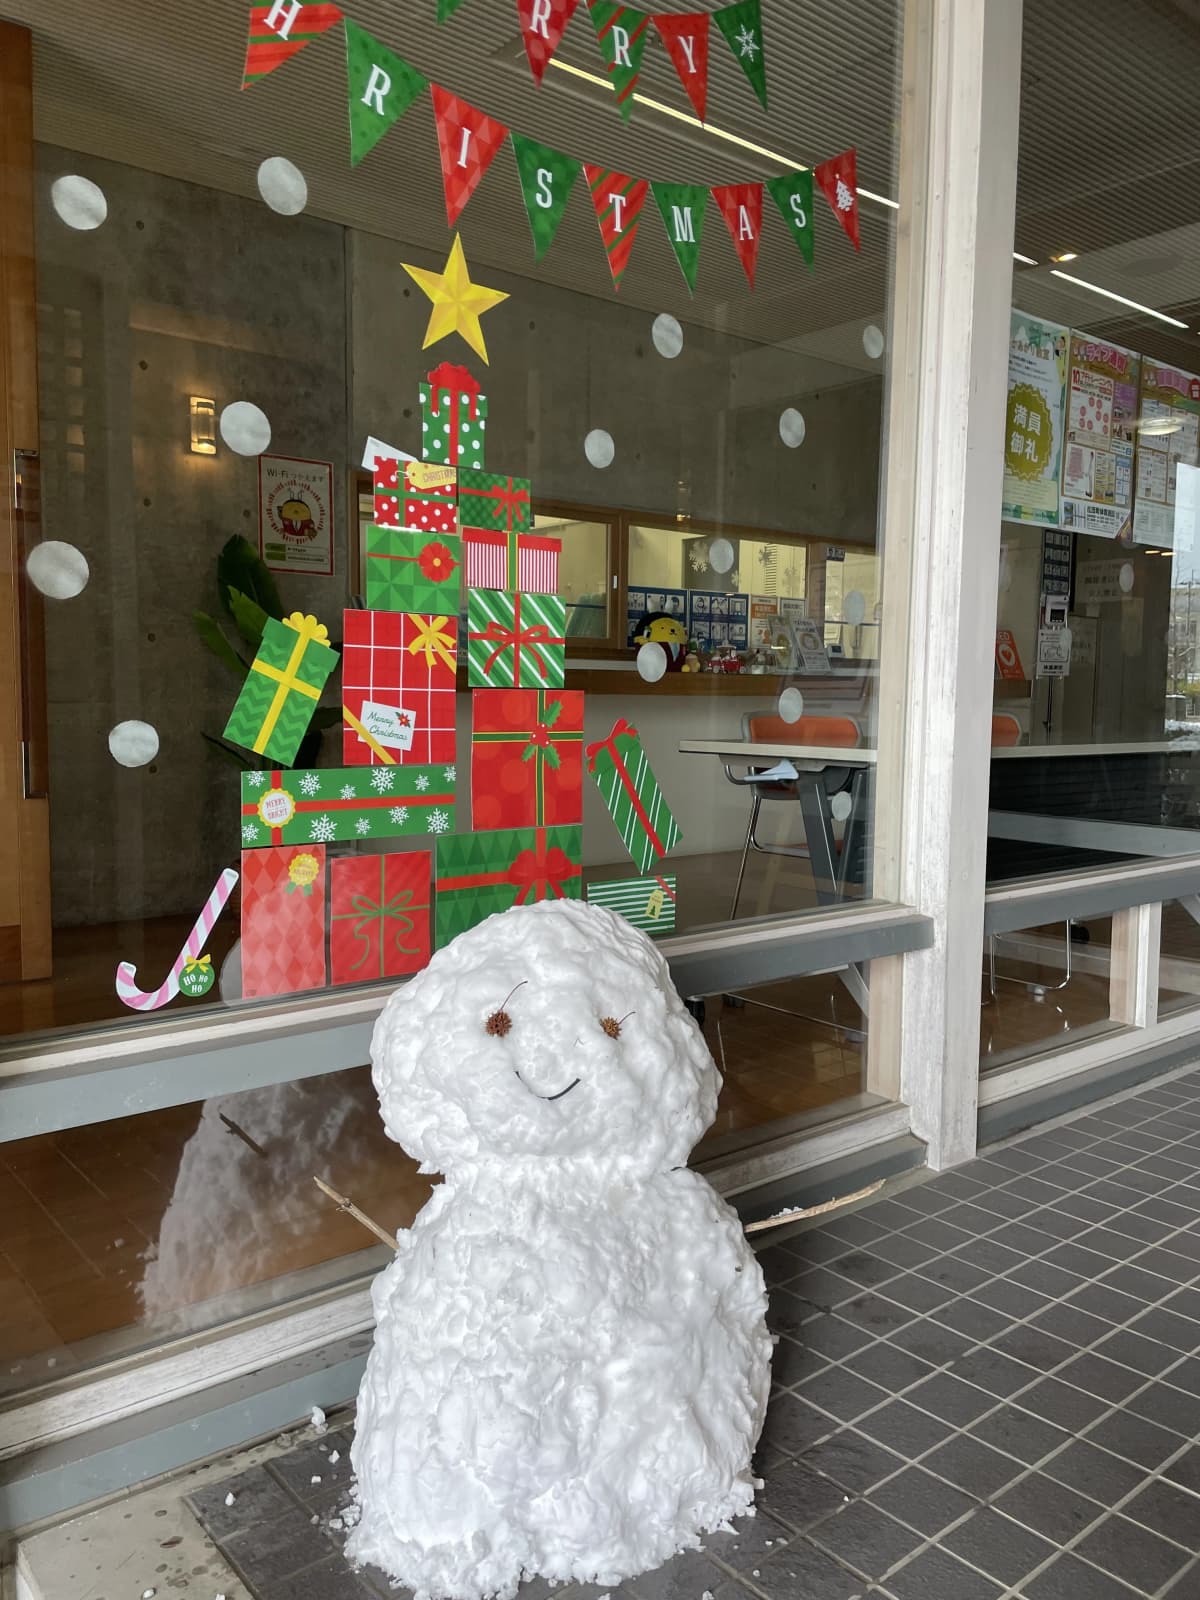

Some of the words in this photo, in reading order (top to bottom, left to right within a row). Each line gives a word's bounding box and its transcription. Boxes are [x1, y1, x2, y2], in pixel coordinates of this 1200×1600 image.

[1013, 402, 1041, 436] 満員
[1011, 430, 1039, 463] 御礼
[184, 974, 196, 985] HO
[199, 975, 208, 983] HO
[191, 984, 203, 993] HO
